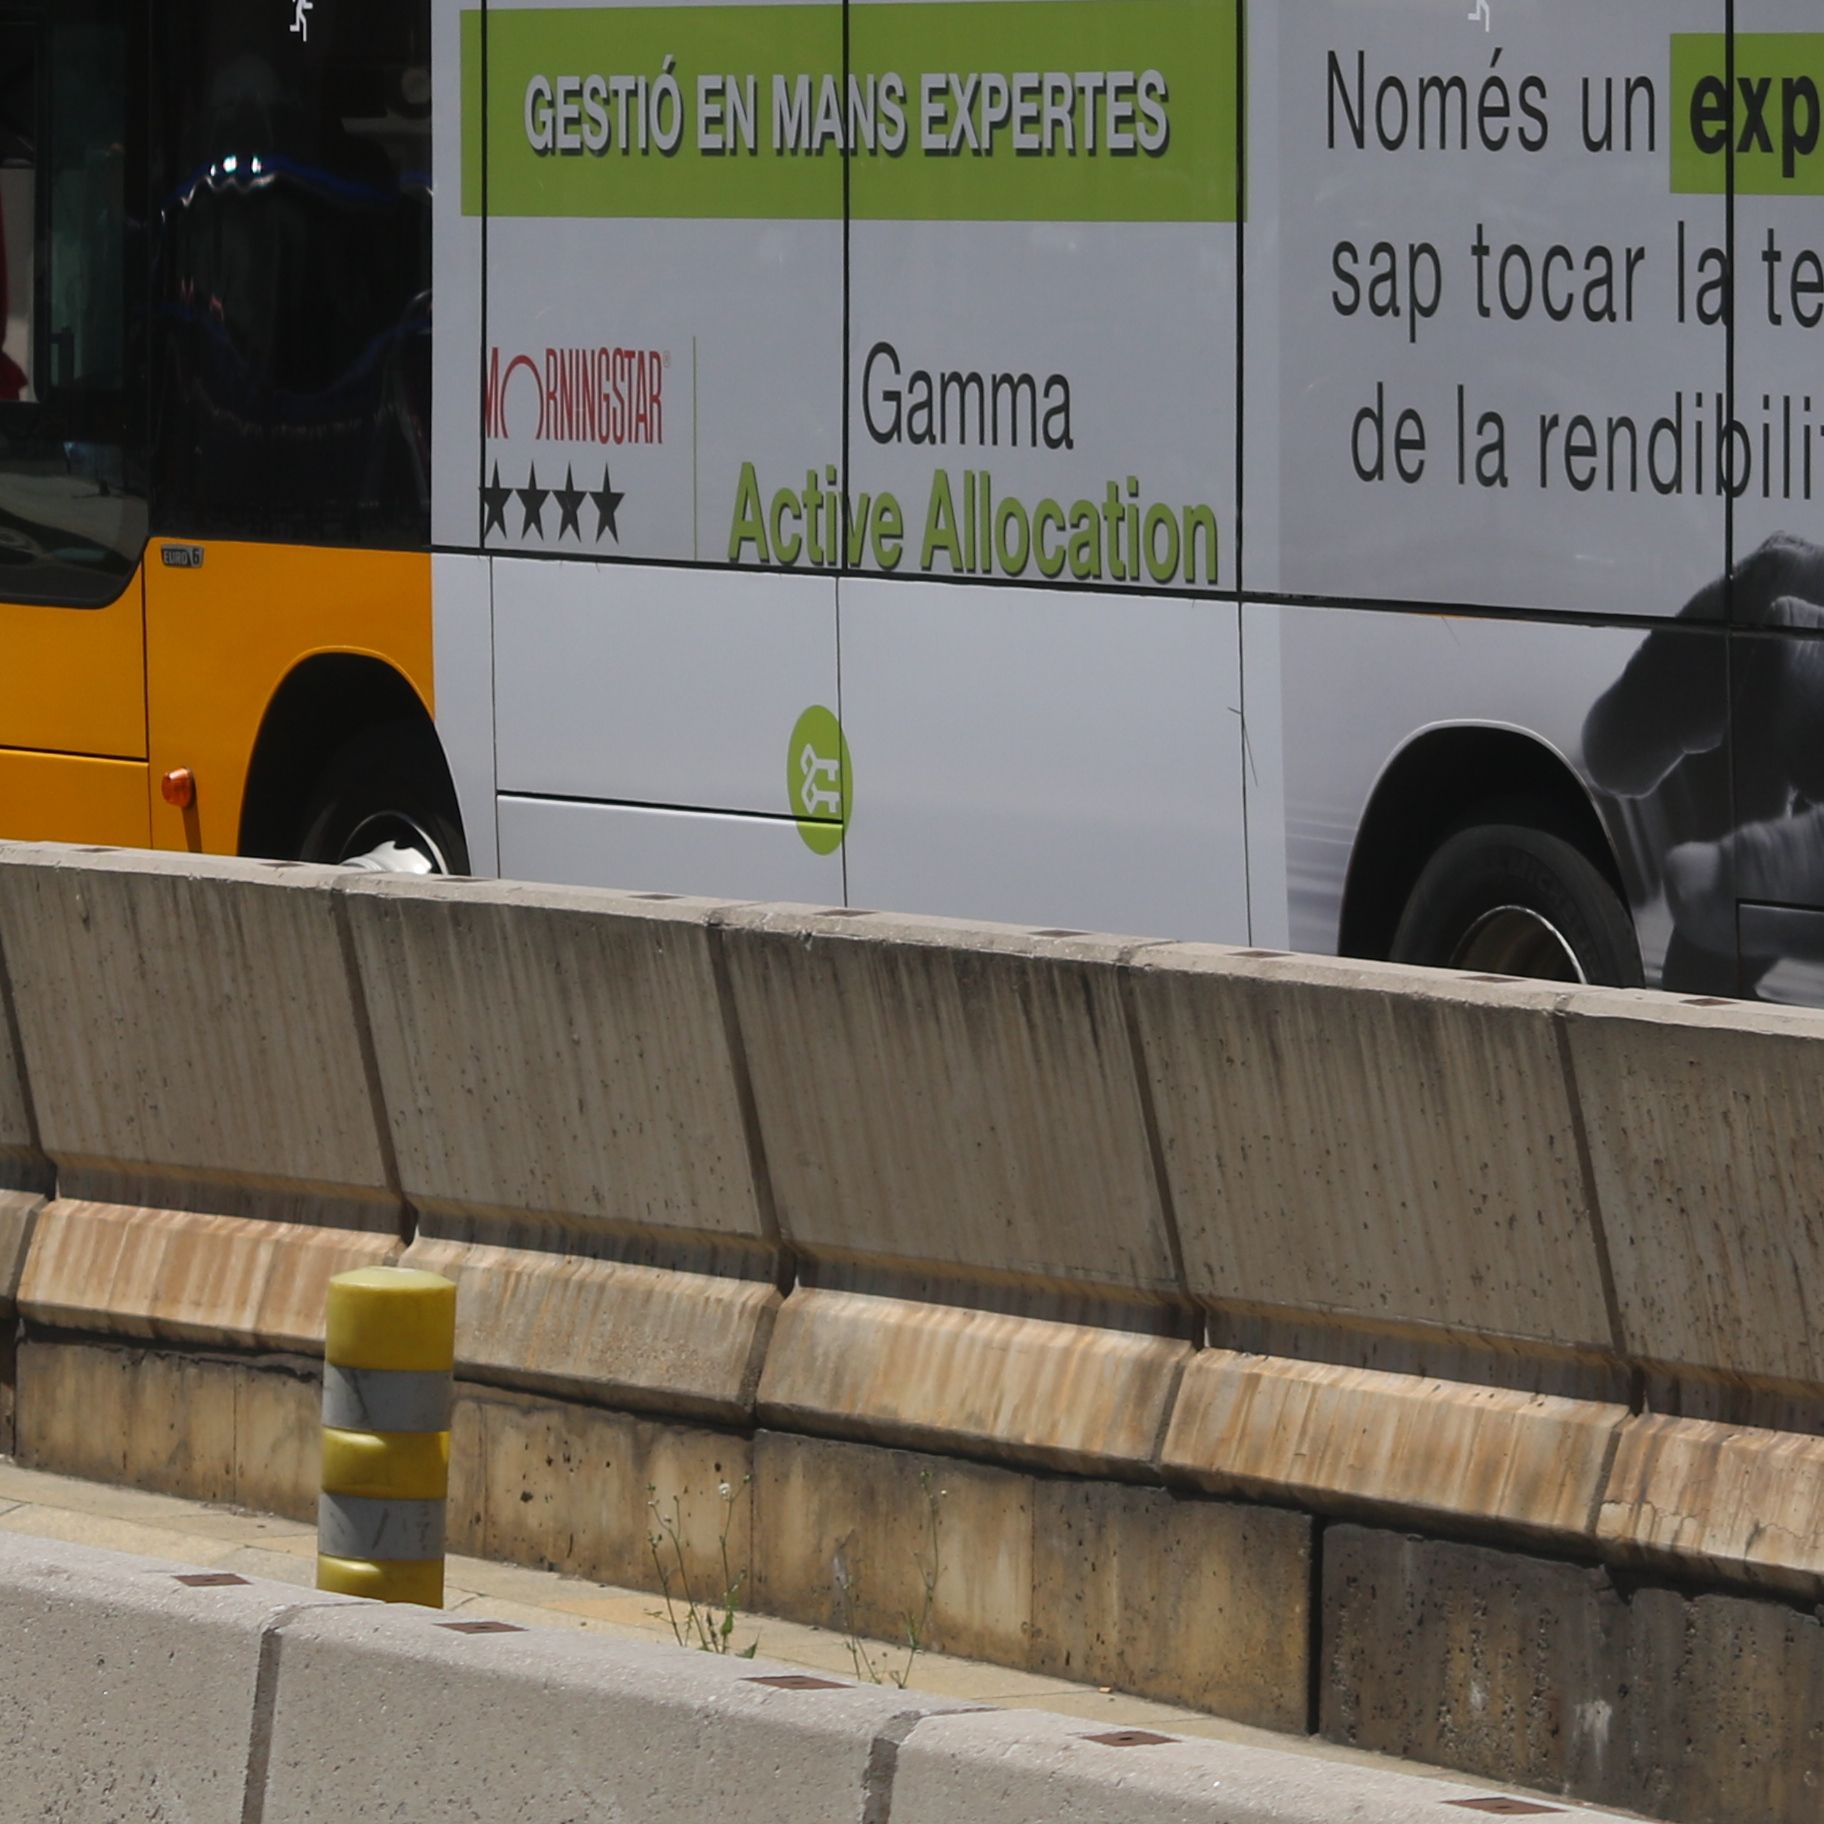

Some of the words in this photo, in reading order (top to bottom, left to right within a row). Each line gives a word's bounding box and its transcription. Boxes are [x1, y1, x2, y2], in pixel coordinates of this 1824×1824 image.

[524, 54, 683, 156] GESTIÓ
[697, 75, 758, 155] EN
[772, 72, 909, 155] MANS
[921, 69, 1171, 157] EXPERTES
[1326, 48, 1549, 152] Només
[1581, 76, 1657, 152] un
[1331, 237, 1443, 344] sap
[1471, 223, 1646, 324] tocar
[1677, 220, 1732, 326] la
[862, 341, 1074, 449] Gamma
[1351, 382, 1427, 484] de
[1457, 384, 1508, 489] la
[728, 462, 903, 570] Active
[921, 469, 1220, 583] Allocation
